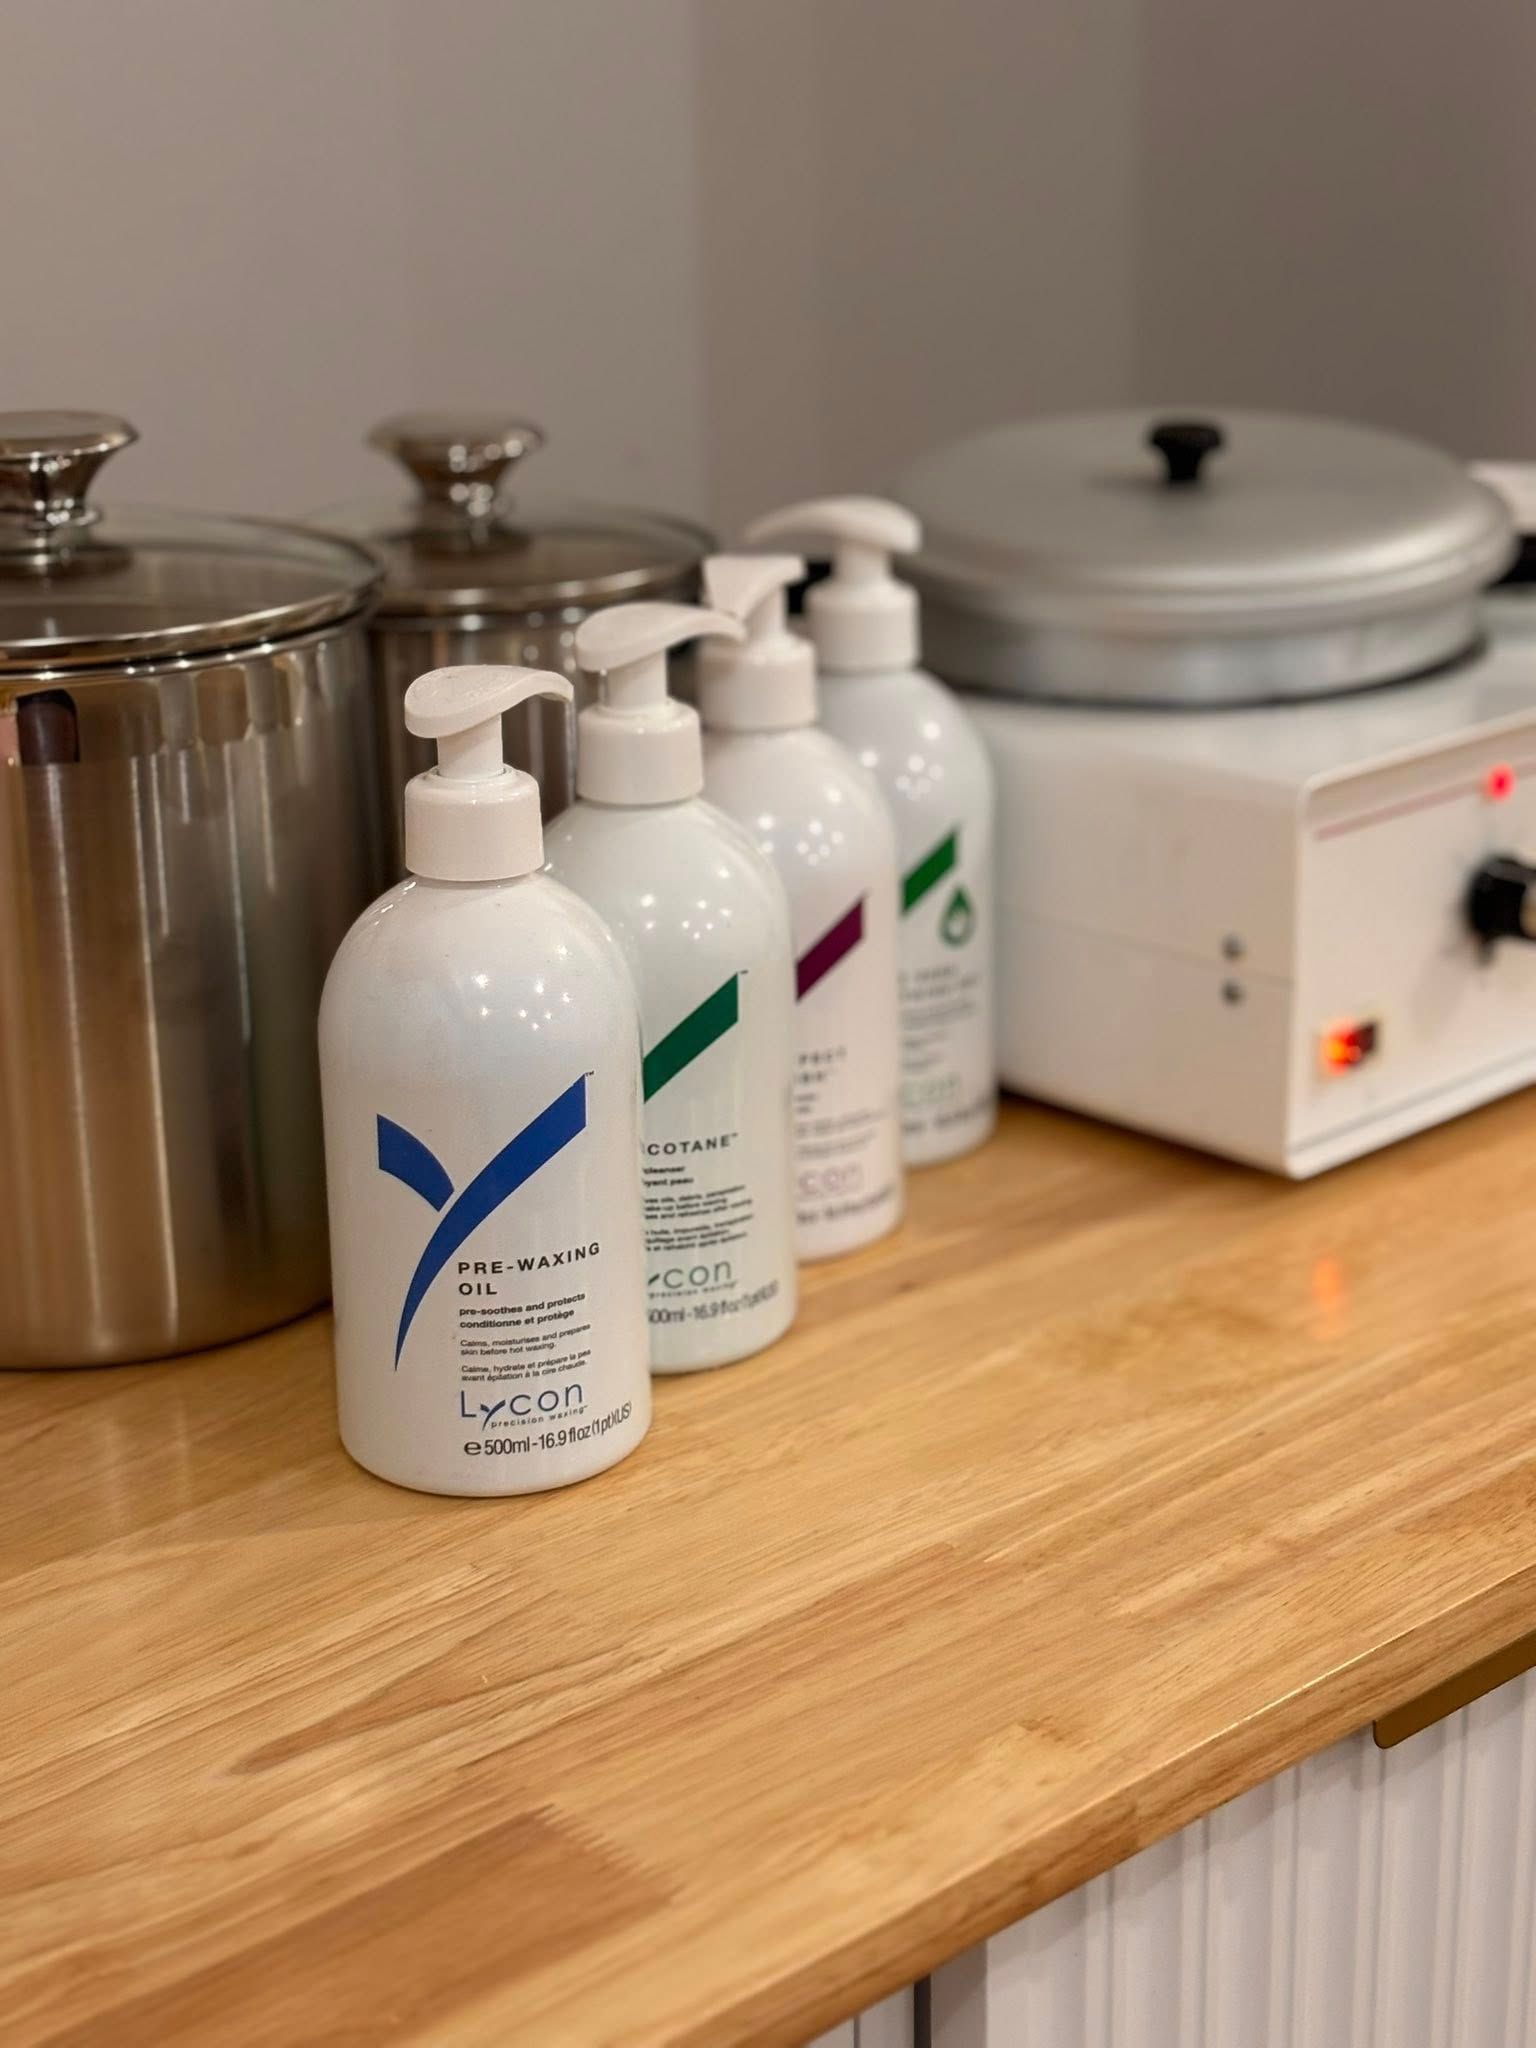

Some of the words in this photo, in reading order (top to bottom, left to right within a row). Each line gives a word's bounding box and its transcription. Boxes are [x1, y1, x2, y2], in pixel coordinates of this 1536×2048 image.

[458, 1242, 600, 1275] PRE-WAXING
[458, 1282, 498, 1296] OIL
[459, 1306, 523, 1317] pre-soothes
[525, 1302, 545, 1312] and
[547, 1293, 586, 1310] protects
[459, 1318, 522, 1329] conditionne
[524, 1315, 535, 1325] et
[537, 1309, 575, 1325] protège
[492, 1336, 540, 1346] moisturises
[542, 1331, 558, 1341] and
[559, 1324, 591, 1338] prepares
[460, 1348, 478, 1356] skin
[480, 1347, 508, 1356] before
[509, 1346, 523, 1354] hot
[493, 1363, 526, 1373] hydrate
[537, 1356, 569, 1369] prépare
[461, 1374, 485, 1382] avant
[487, 1373, 523, 1382] épilation
[532, 1369, 540, 1377] la
[541, 1366, 557, 1375] cire
[460, 1383, 583, 1431] Lycon
[491, 1415, 544, 1429] precision
